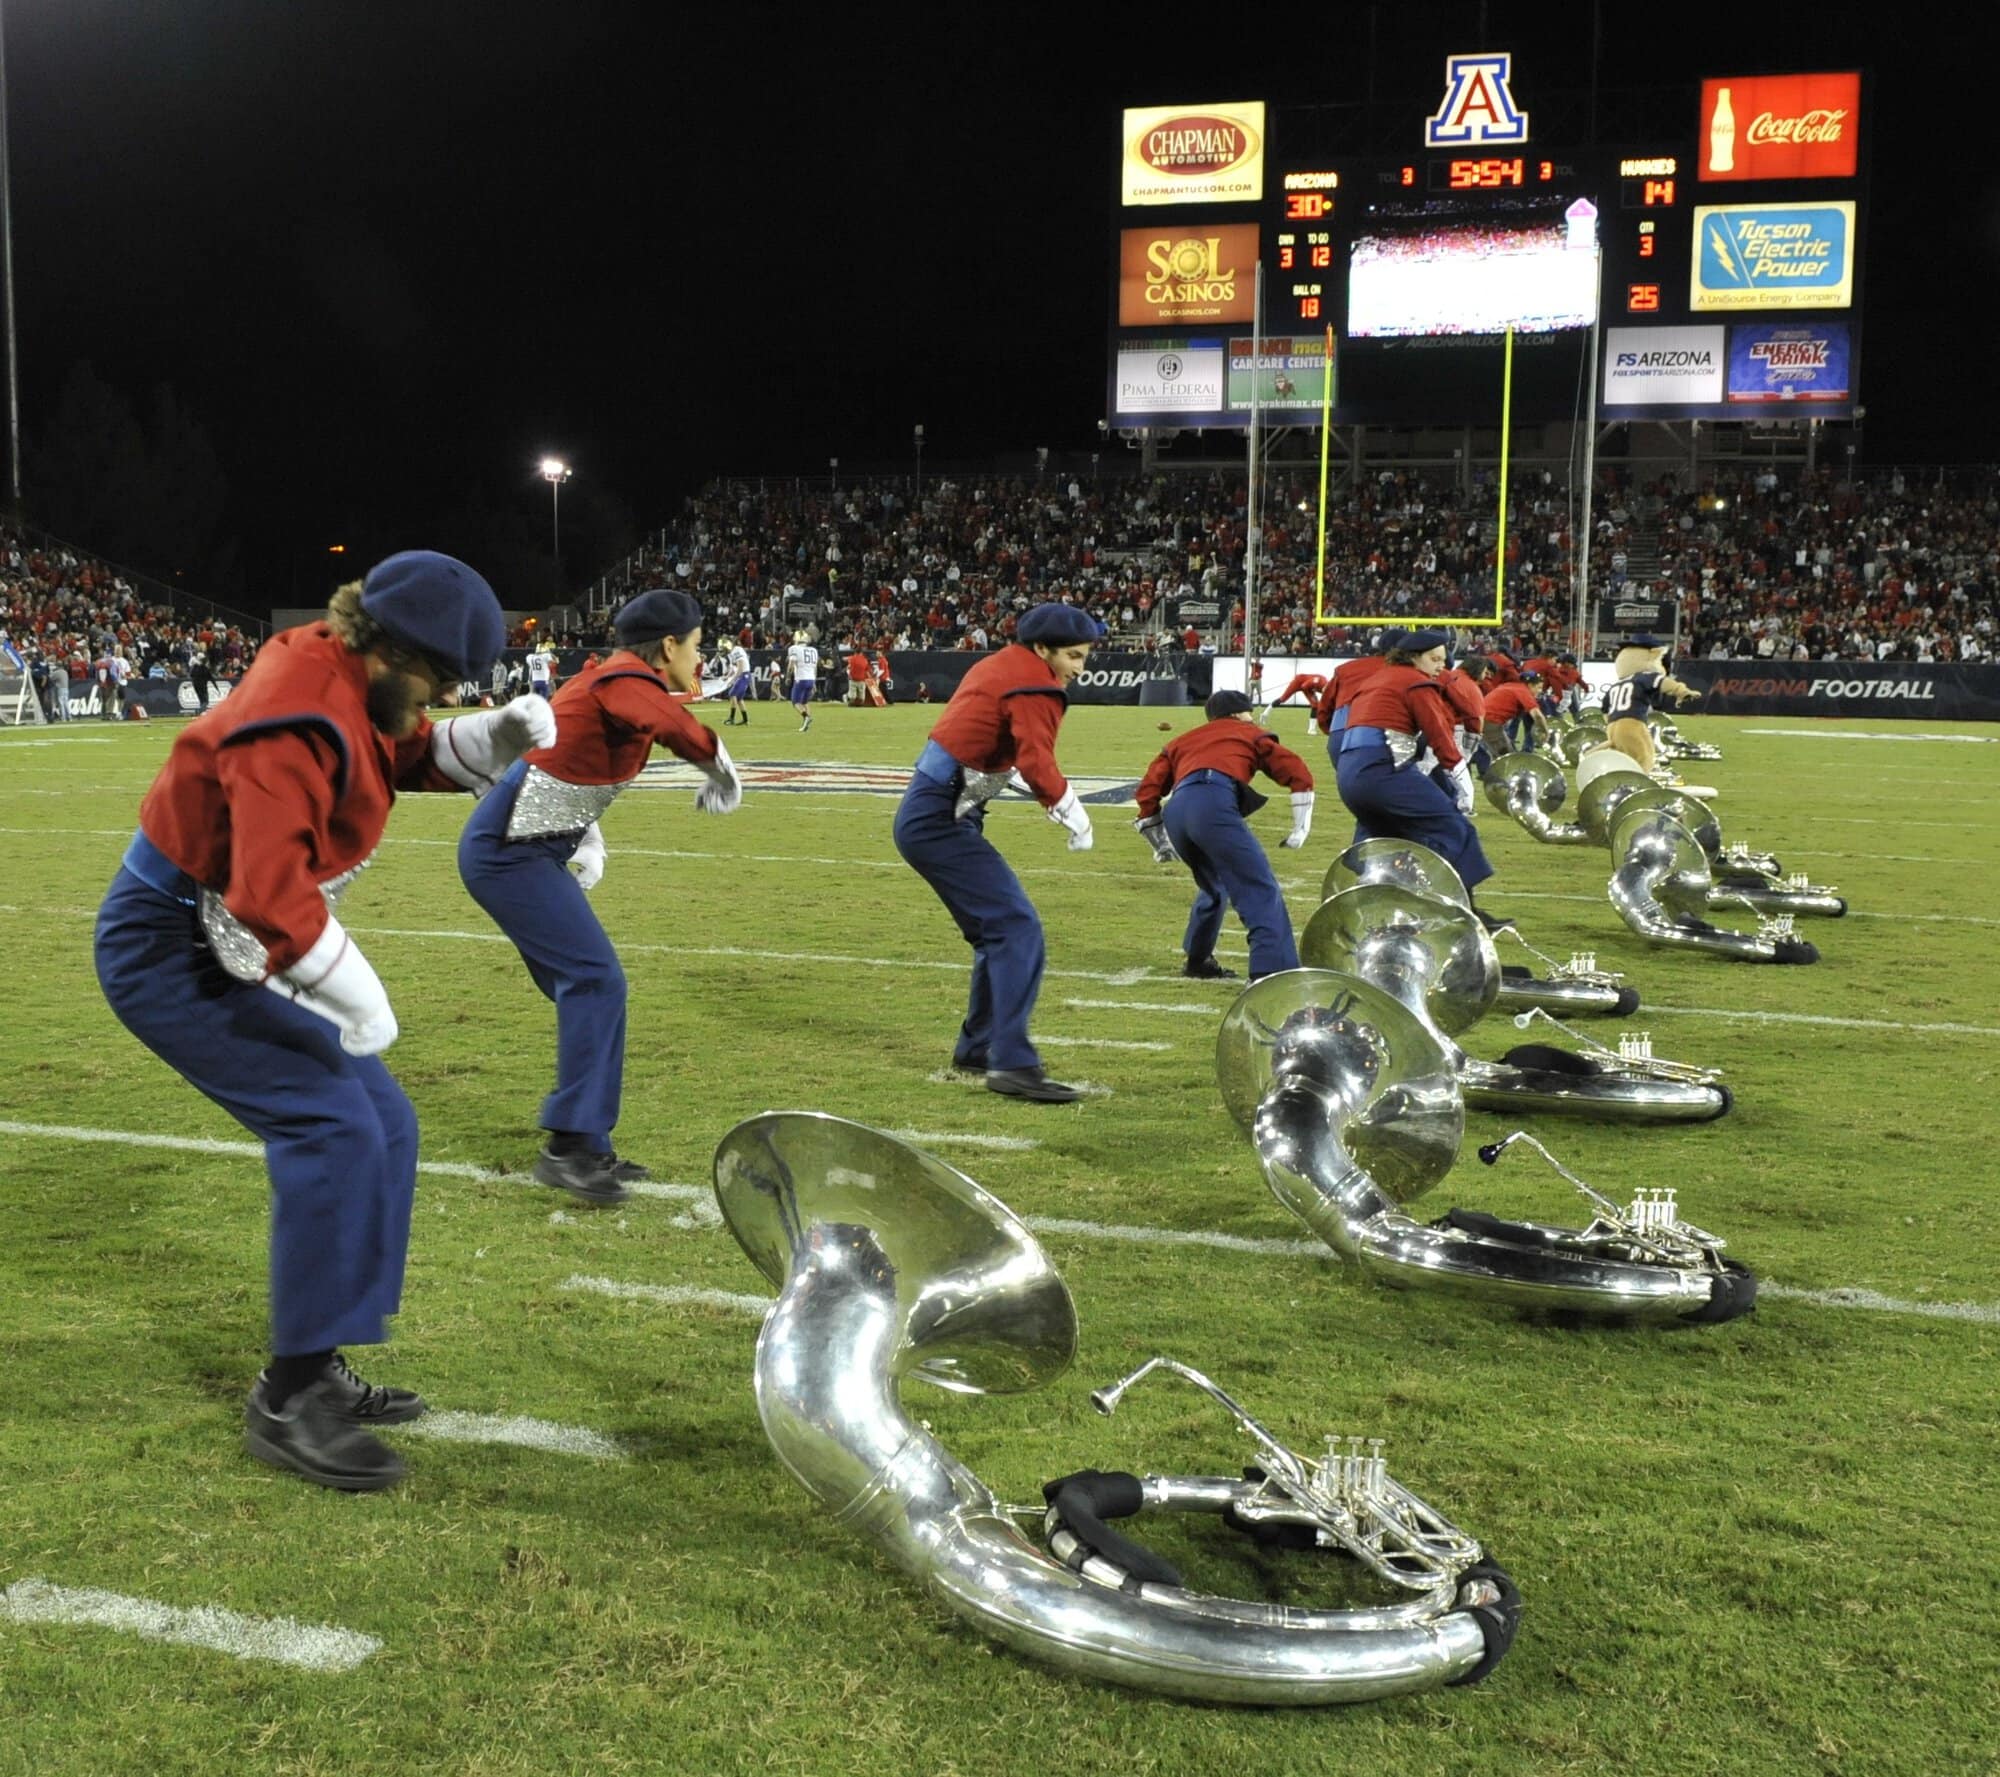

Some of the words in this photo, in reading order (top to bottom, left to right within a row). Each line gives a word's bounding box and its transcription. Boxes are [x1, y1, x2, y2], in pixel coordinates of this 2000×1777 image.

[1425, 53, 1528, 147] A
[1746, 109, 1848, 144] Coca-Cola
[1149, 128, 1235, 155] CHAPMAN
[1151, 153, 1235, 166] AUTOMOTIVE
[1402, 167, 1413, 185] 3
[1450, 159, 1522, 187] 5:54
[1540, 162, 1552, 180] 3
[1133, 184, 1252, 196] CHAPMANTUCSON.COM
[1644, 180, 1674, 205] 14
[1287, 195, 1323, 218] 30
[1737, 220, 1812, 240] Tucson
[1640, 236, 1653, 256] 3
[1744, 238, 1831, 258] Electric
[1145, 238, 1235, 285] SOL
[1280, 248, 1293, 268] 3
[1312, 246, 1330, 267] 12
[1751, 258, 1830, 278] Power
[1145, 282, 1235, 303] CASINOS
[1630, 285, 1658, 310] 25
[1697, 295, 1705, 304] A
[1708, 294, 1757, 304] UniSource
[1759, 292, 1793, 304] Energy
[1795, 292, 1841, 304] Company
[1159, 308, 1221, 317] SOLCASINOS.COM
[1405, 335, 1556, 349] ARIZONAWILDCAS.COM
[1751, 341, 1825, 356] ENERGY
[1258, 357, 1284, 369] CARE
[1616, 353, 1637, 366] FS
[1638, 351, 1712, 366] ARIZONA
[1768, 351, 1825, 366] DRINK
[1122, 384, 1156, 397] PIMA
[1162, 382, 1217, 395] FEDERAL
[803, 650, 818, 665] 60
[1709, 679, 1809, 697] ARIZONA
[1807, 679, 1935, 698] FOOTBALL
[64, 684, 102, 716] ash
